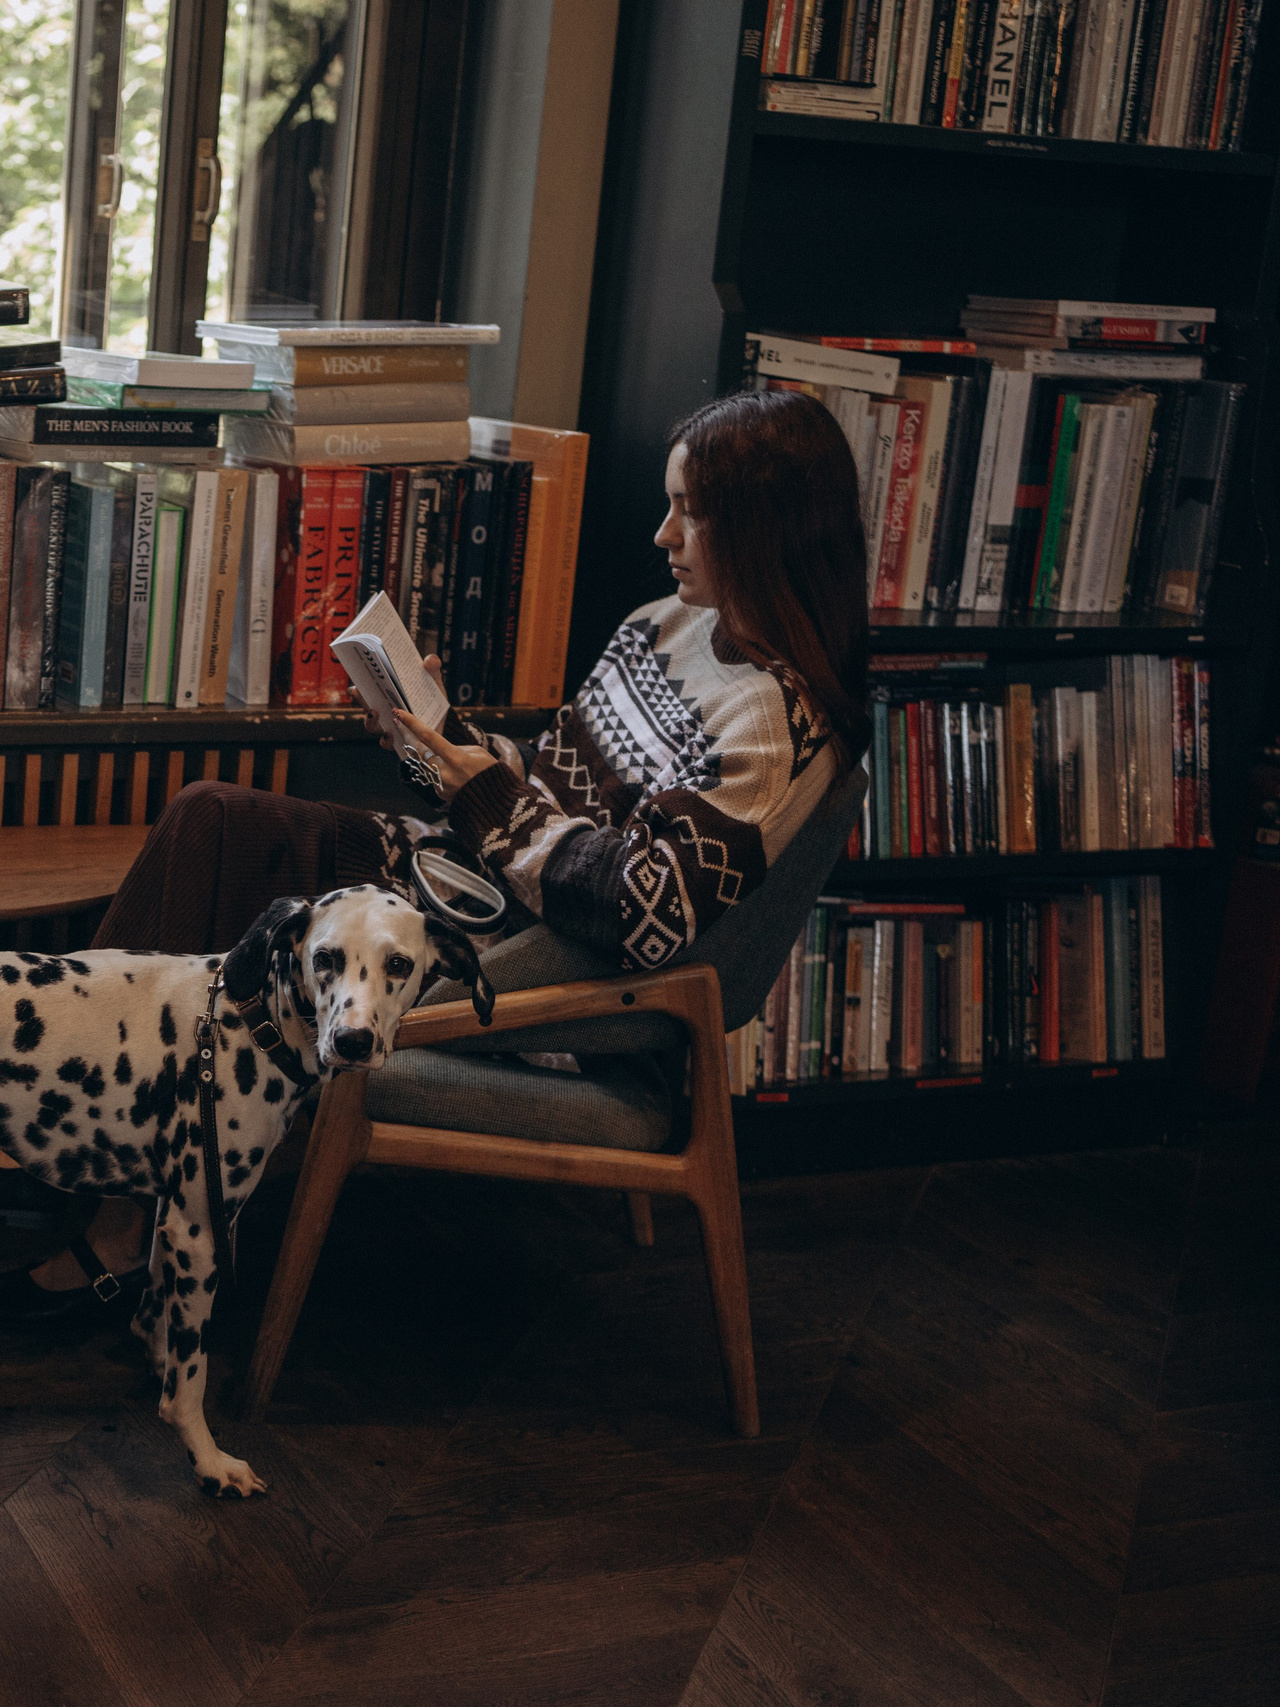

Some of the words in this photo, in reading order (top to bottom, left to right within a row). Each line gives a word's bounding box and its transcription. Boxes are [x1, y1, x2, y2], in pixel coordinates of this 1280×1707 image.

[321, 355, 384, 375] VERSACE
[46, 420, 70, 432] THE
[71, 420, 109, 433] MEN'S
[110, 421, 159, 433] FASHION
[161, 422, 193, 434] BOOK
[325, 434, 381, 456] Chloé
[898, 409, 921, 470] Kenzo
[223, 488, 236, 523] Lauren
[416, 498, 431, 524] The
[889, 474, 914, 543] Takada
[133, 492, 154, 603] PARACHUTE
[217, 525, 232, 575] Greenfield
[411, 527, 429, 588] Ultimate
[44, 567, 57, 616] FASHION
[210, 589, 226, 643] Generation
[300, 526, 325, 665] FABRICS
[408, 591, 425, 645] Sneake
[208, 644, 220, 678] Wealth
